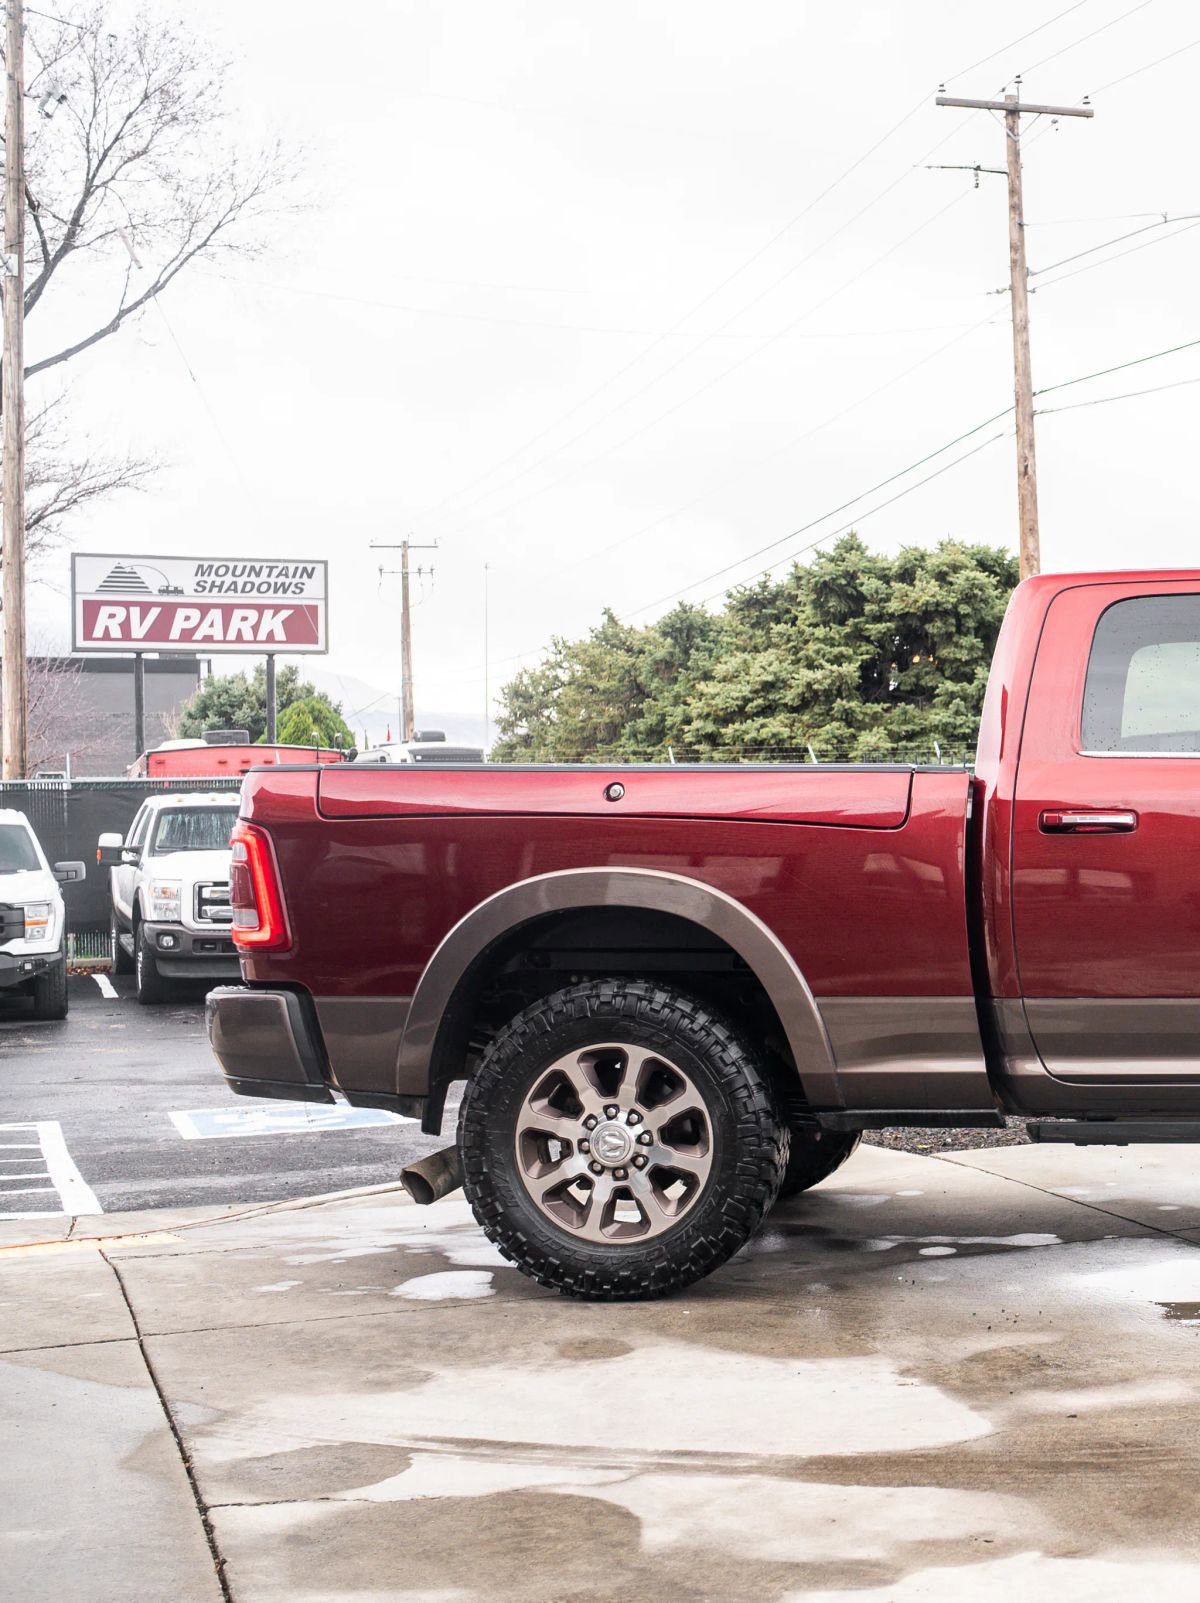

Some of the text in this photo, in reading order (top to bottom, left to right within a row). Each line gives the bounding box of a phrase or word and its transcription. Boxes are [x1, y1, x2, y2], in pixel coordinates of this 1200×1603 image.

[194, 564, 316, 579] MOUNTAIN
[193, 580, 306, 595] SHADOWS
[92, 605, 294, 641] RV PARK
